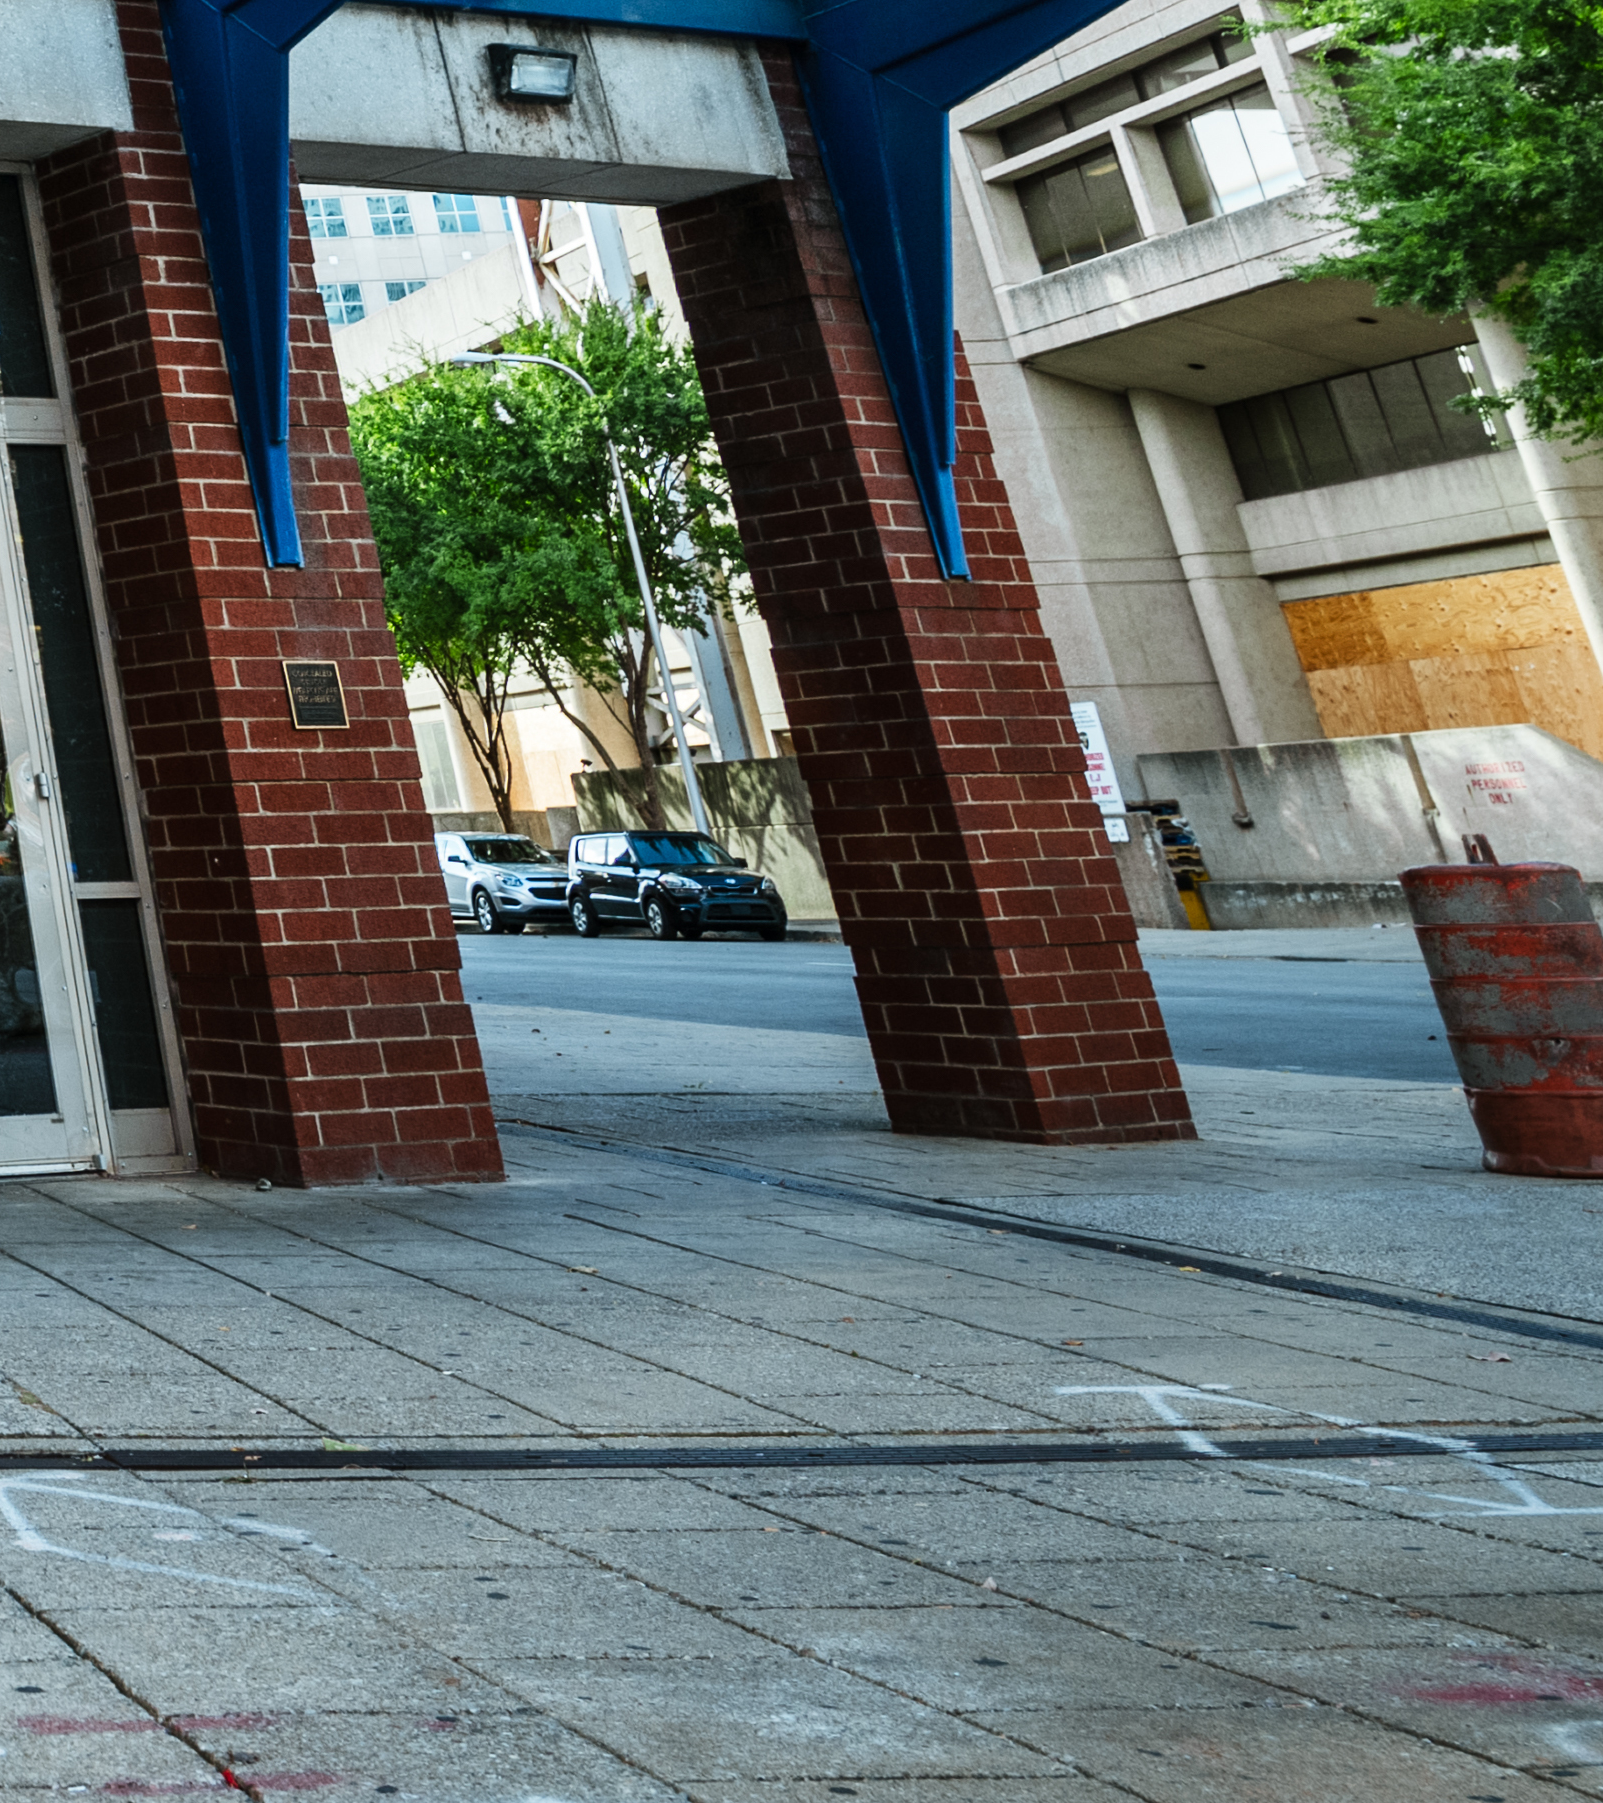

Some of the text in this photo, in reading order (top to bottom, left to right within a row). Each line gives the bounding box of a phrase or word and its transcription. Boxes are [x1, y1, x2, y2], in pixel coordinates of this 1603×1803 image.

[1465, 760, 1525, 775] AUTHORIZED
[1471, 777, 1527, 791] PERSONNEL
[1488, 792, 1513, 804] ONLY
